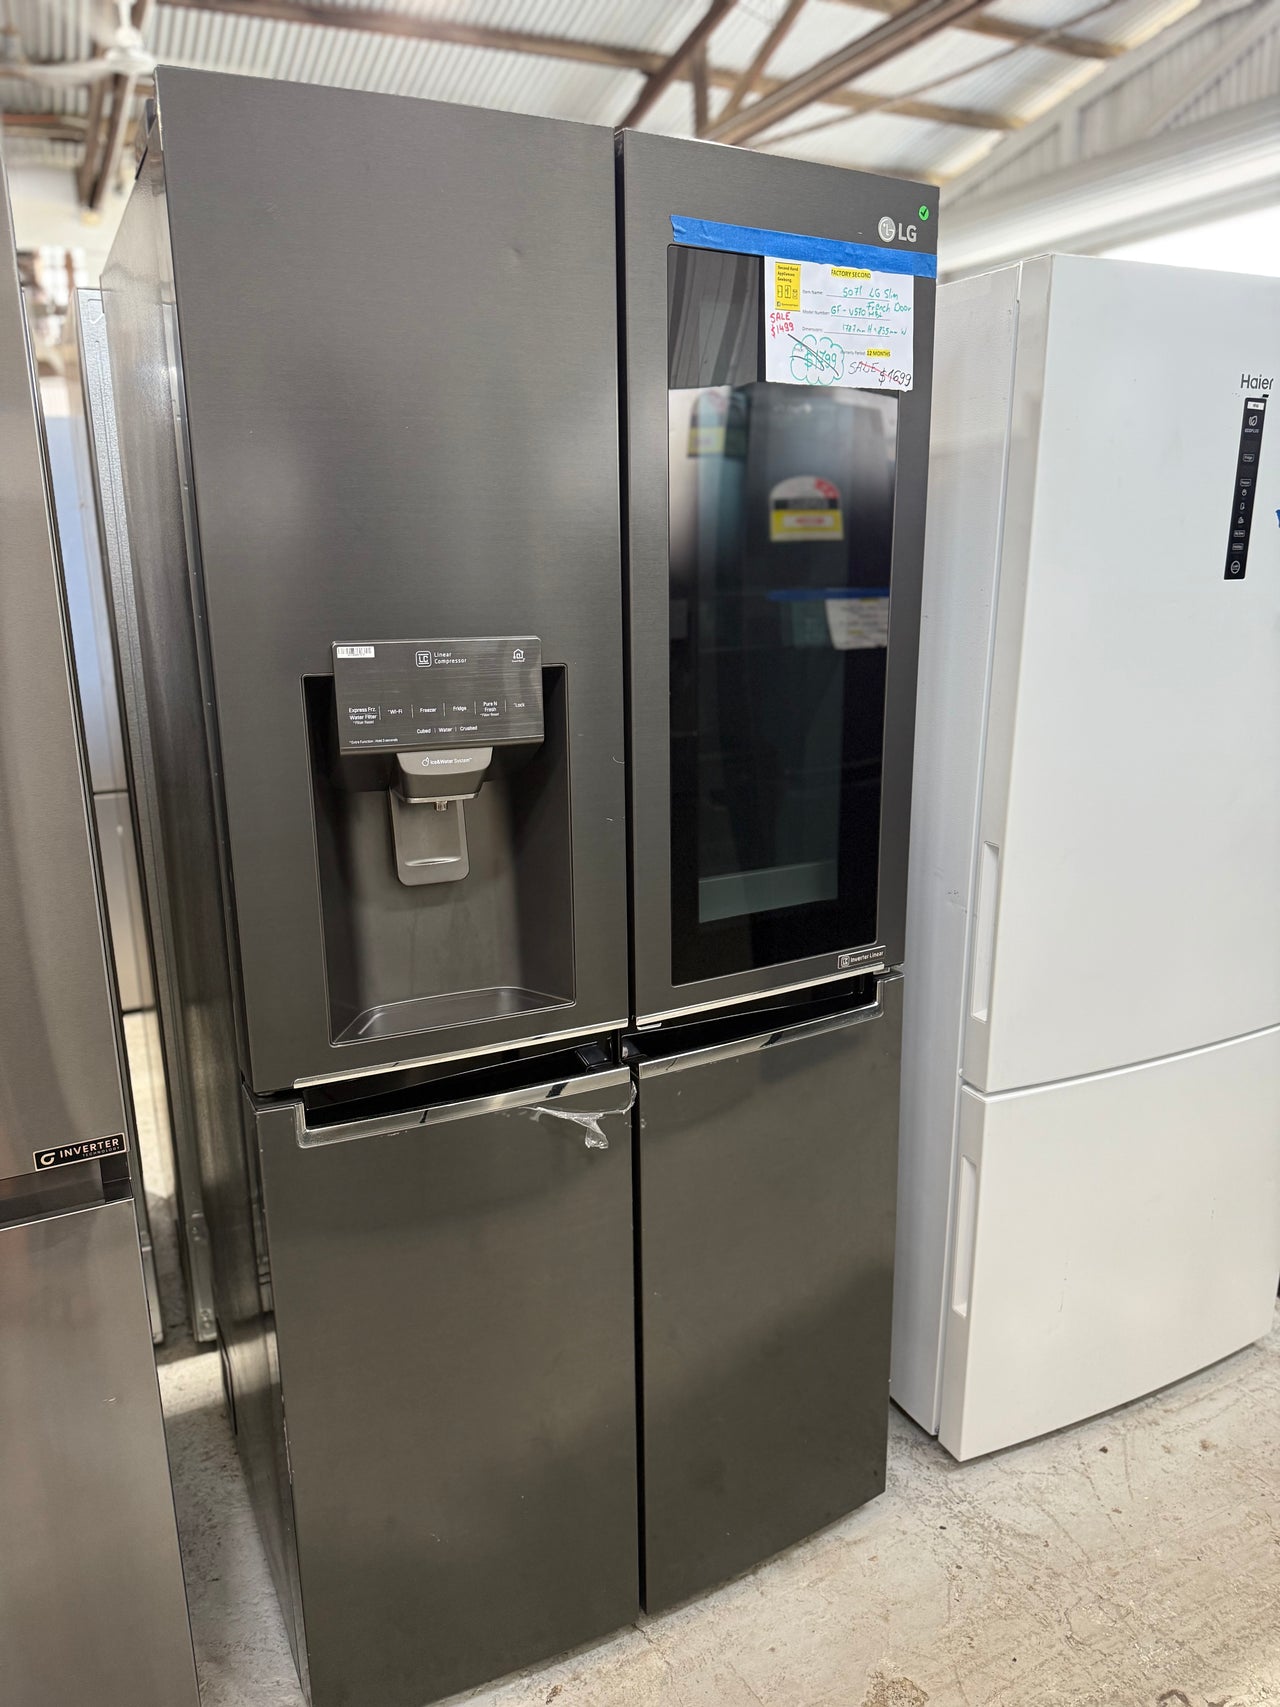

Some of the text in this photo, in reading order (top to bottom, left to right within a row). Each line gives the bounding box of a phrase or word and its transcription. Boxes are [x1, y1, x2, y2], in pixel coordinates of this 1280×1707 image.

[898, 222, 917, 243] LG
[830, 269, 872, 279] FACTORY SECOND
[869, 287, 881, 298] LG
[769, 311, 791, 323] SALE
[770, 321, 795, 340] $1499
[872, 350, 891, 358] MONTHS
[1240, 373, 1274, 390] Haier
[60, 1138, 119, 1158] INVERTER
